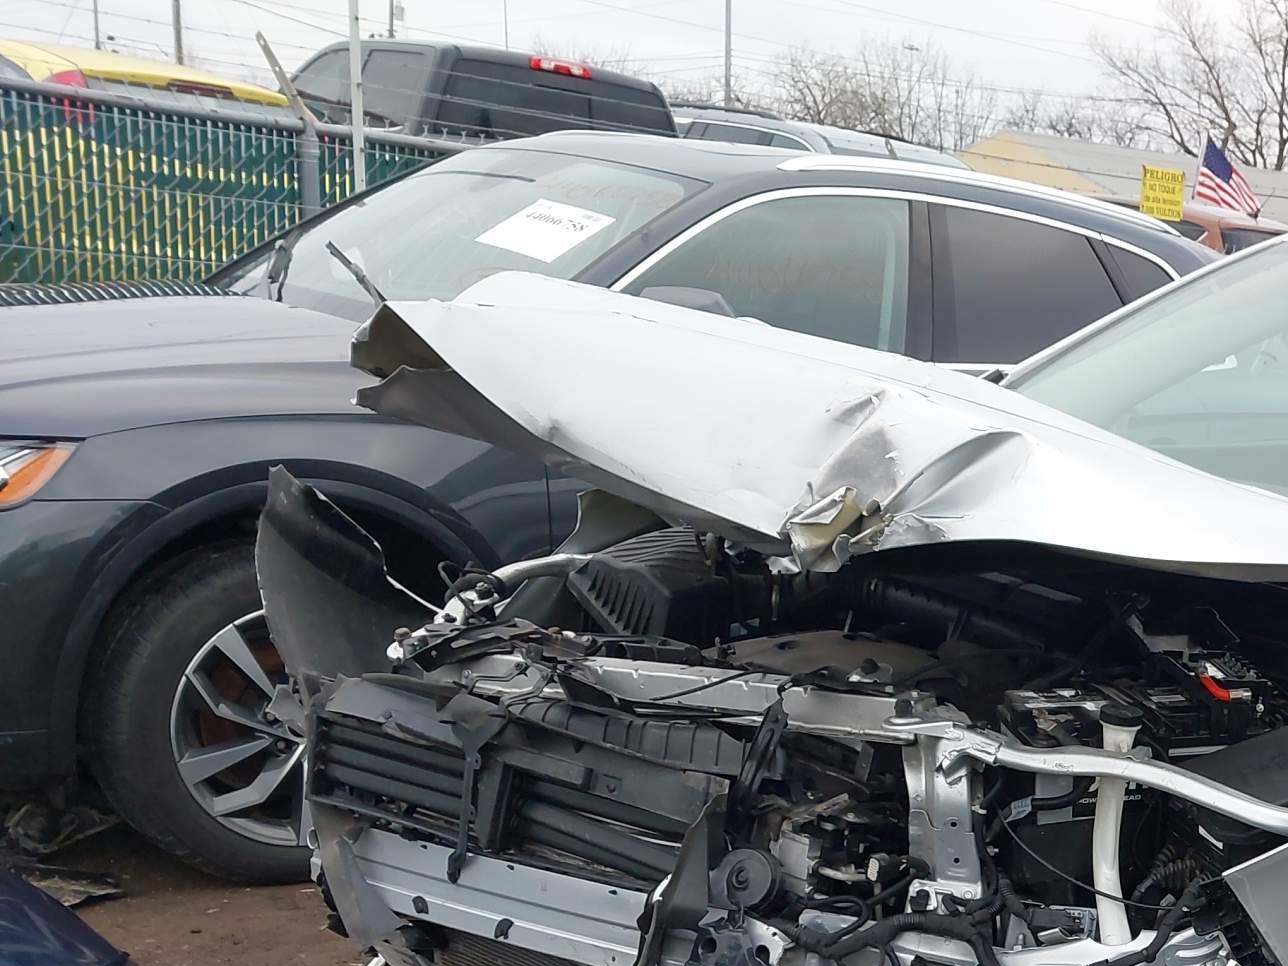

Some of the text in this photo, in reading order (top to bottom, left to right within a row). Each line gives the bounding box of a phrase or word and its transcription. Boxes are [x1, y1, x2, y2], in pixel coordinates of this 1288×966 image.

[1144, 168, 1183, 183] PELIGRO
[1148, 183, 1177, 195] NO TOQUE
